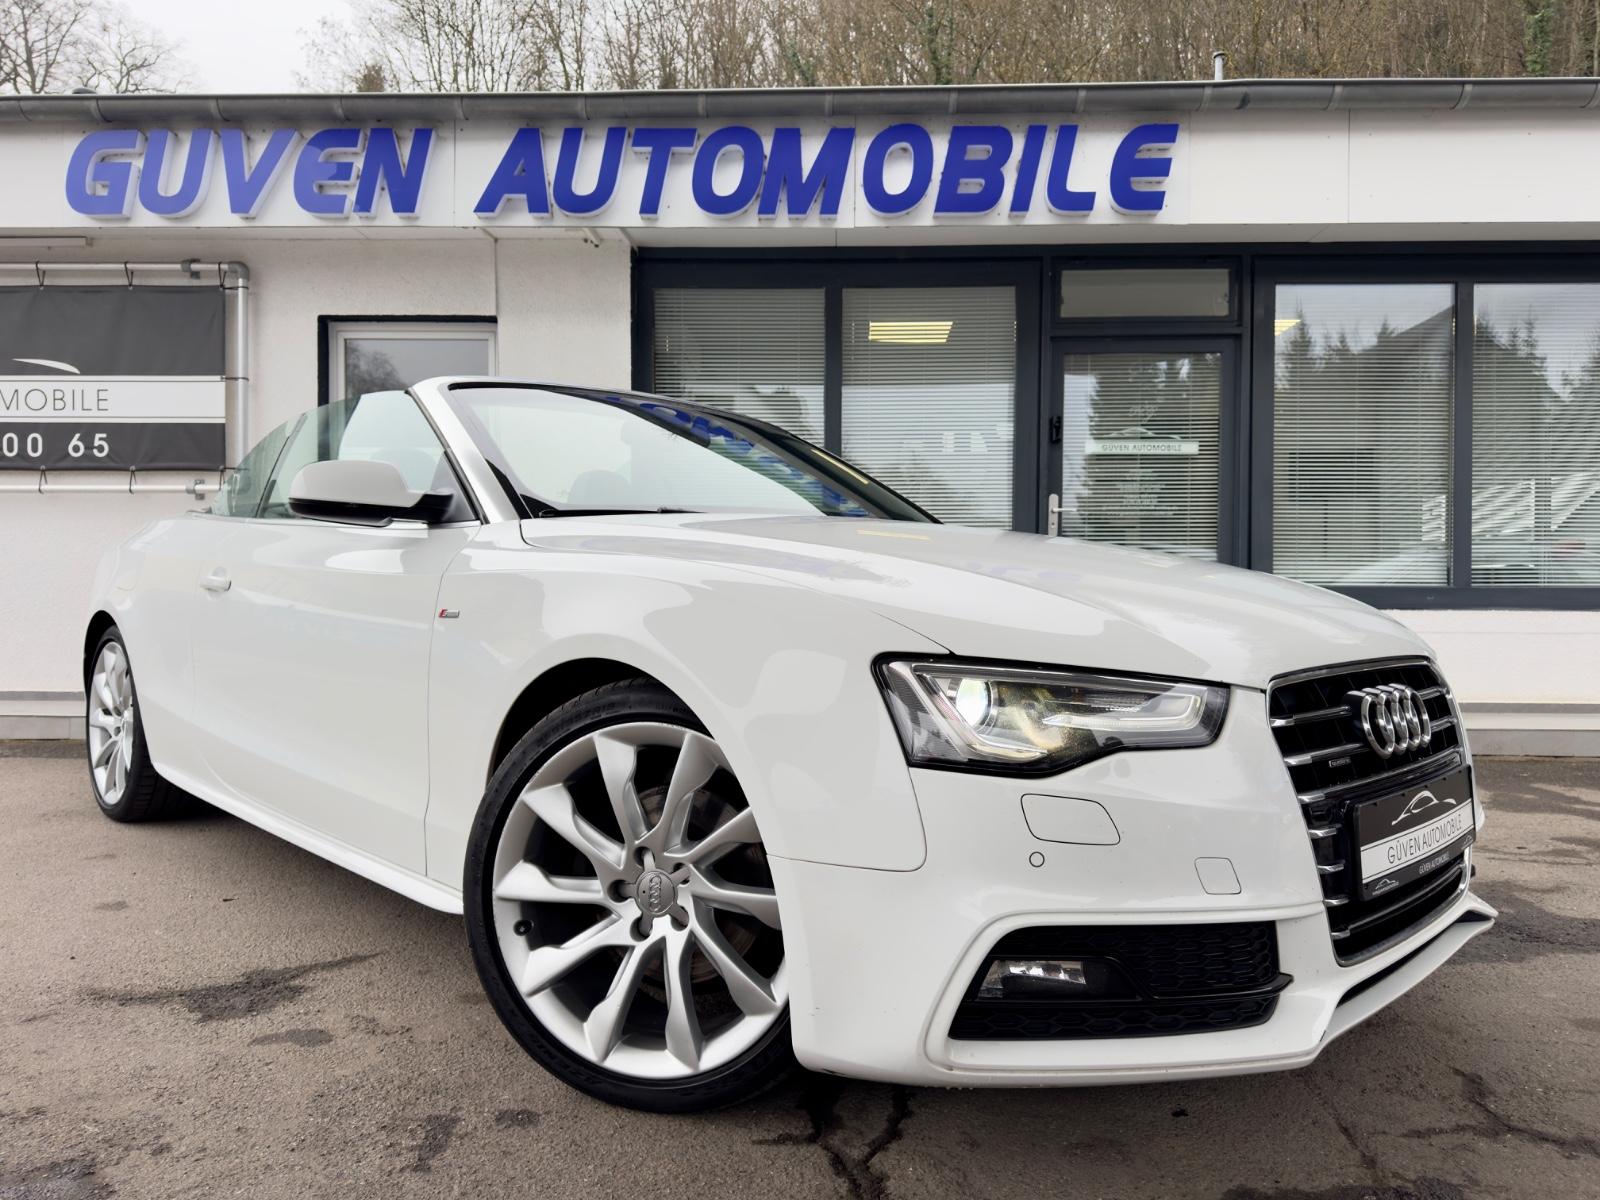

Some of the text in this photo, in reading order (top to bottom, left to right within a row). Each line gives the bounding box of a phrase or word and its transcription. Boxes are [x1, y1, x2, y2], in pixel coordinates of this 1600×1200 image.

[66, 122, 1179, 216] GUVEN AUTOMOBILE
[0, 388, 109, 411] MOBILE
[2, 432, 109, 457] 00 65
[1132, 443, 1183, 452] AUTOMOBILE
[1422, 813, 1462, 849] AUTOMOBILE
